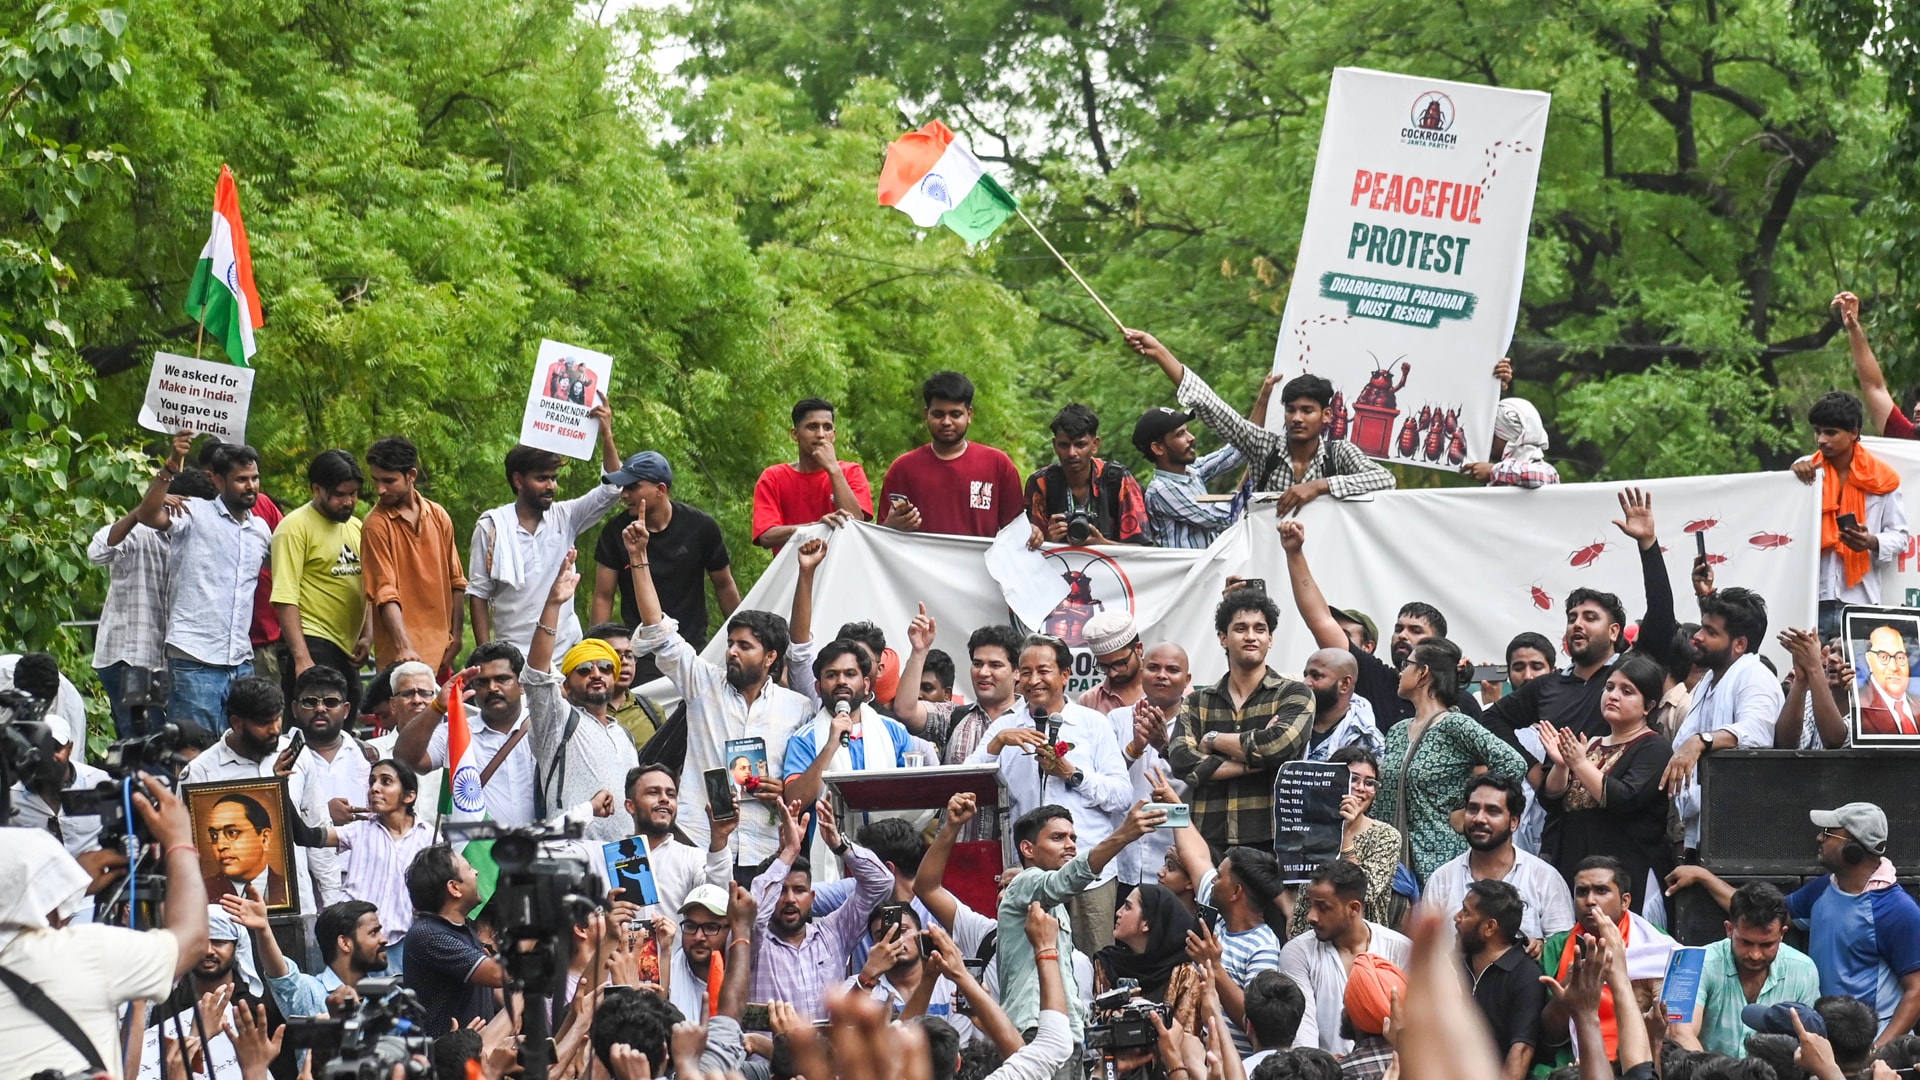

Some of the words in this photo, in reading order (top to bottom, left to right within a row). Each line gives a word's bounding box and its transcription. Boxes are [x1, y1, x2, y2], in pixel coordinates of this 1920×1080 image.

[1401, 128, 1457, 144] COCKROACH
[1407, 139, 1426, 147] JANTA
[1428, 142, 1448, 150] PARTY
[1350, 169, 1482, 224] PEACEFUL
[1347, 222, 1471, 275] PROTEST
[1329, 276, 1410, 302] DHARMENDRA
[1411, 288, 1467, 311] PRADHAN
[1355, 299, 1391, 318] MUST
[1390, 305, 1435, 325] RESIGN
[164, 364, 180, 377] We
[181, 369, 218, 384] asked
[220, 375, 239, 388] for
[158, 379, 187, 394] Make
[189, 385, 200, 397] in
[203, 388, 237, 404] India.
[160, 398, 179, 411] You
[180, 404, 211, 416] gave
[213, 410, 229, 420] us
[540, 399, 591, 419] DHARMENDRA
[545, 411, 581, 427] PRADHAN
[156, 412, 180, 427] Leak
[182, 417, 193, 429] in
[196, 420, 231, 436] India.
[533, 420, 555, 433] MUST
[557, 426, 587, 440] RESIGN!
